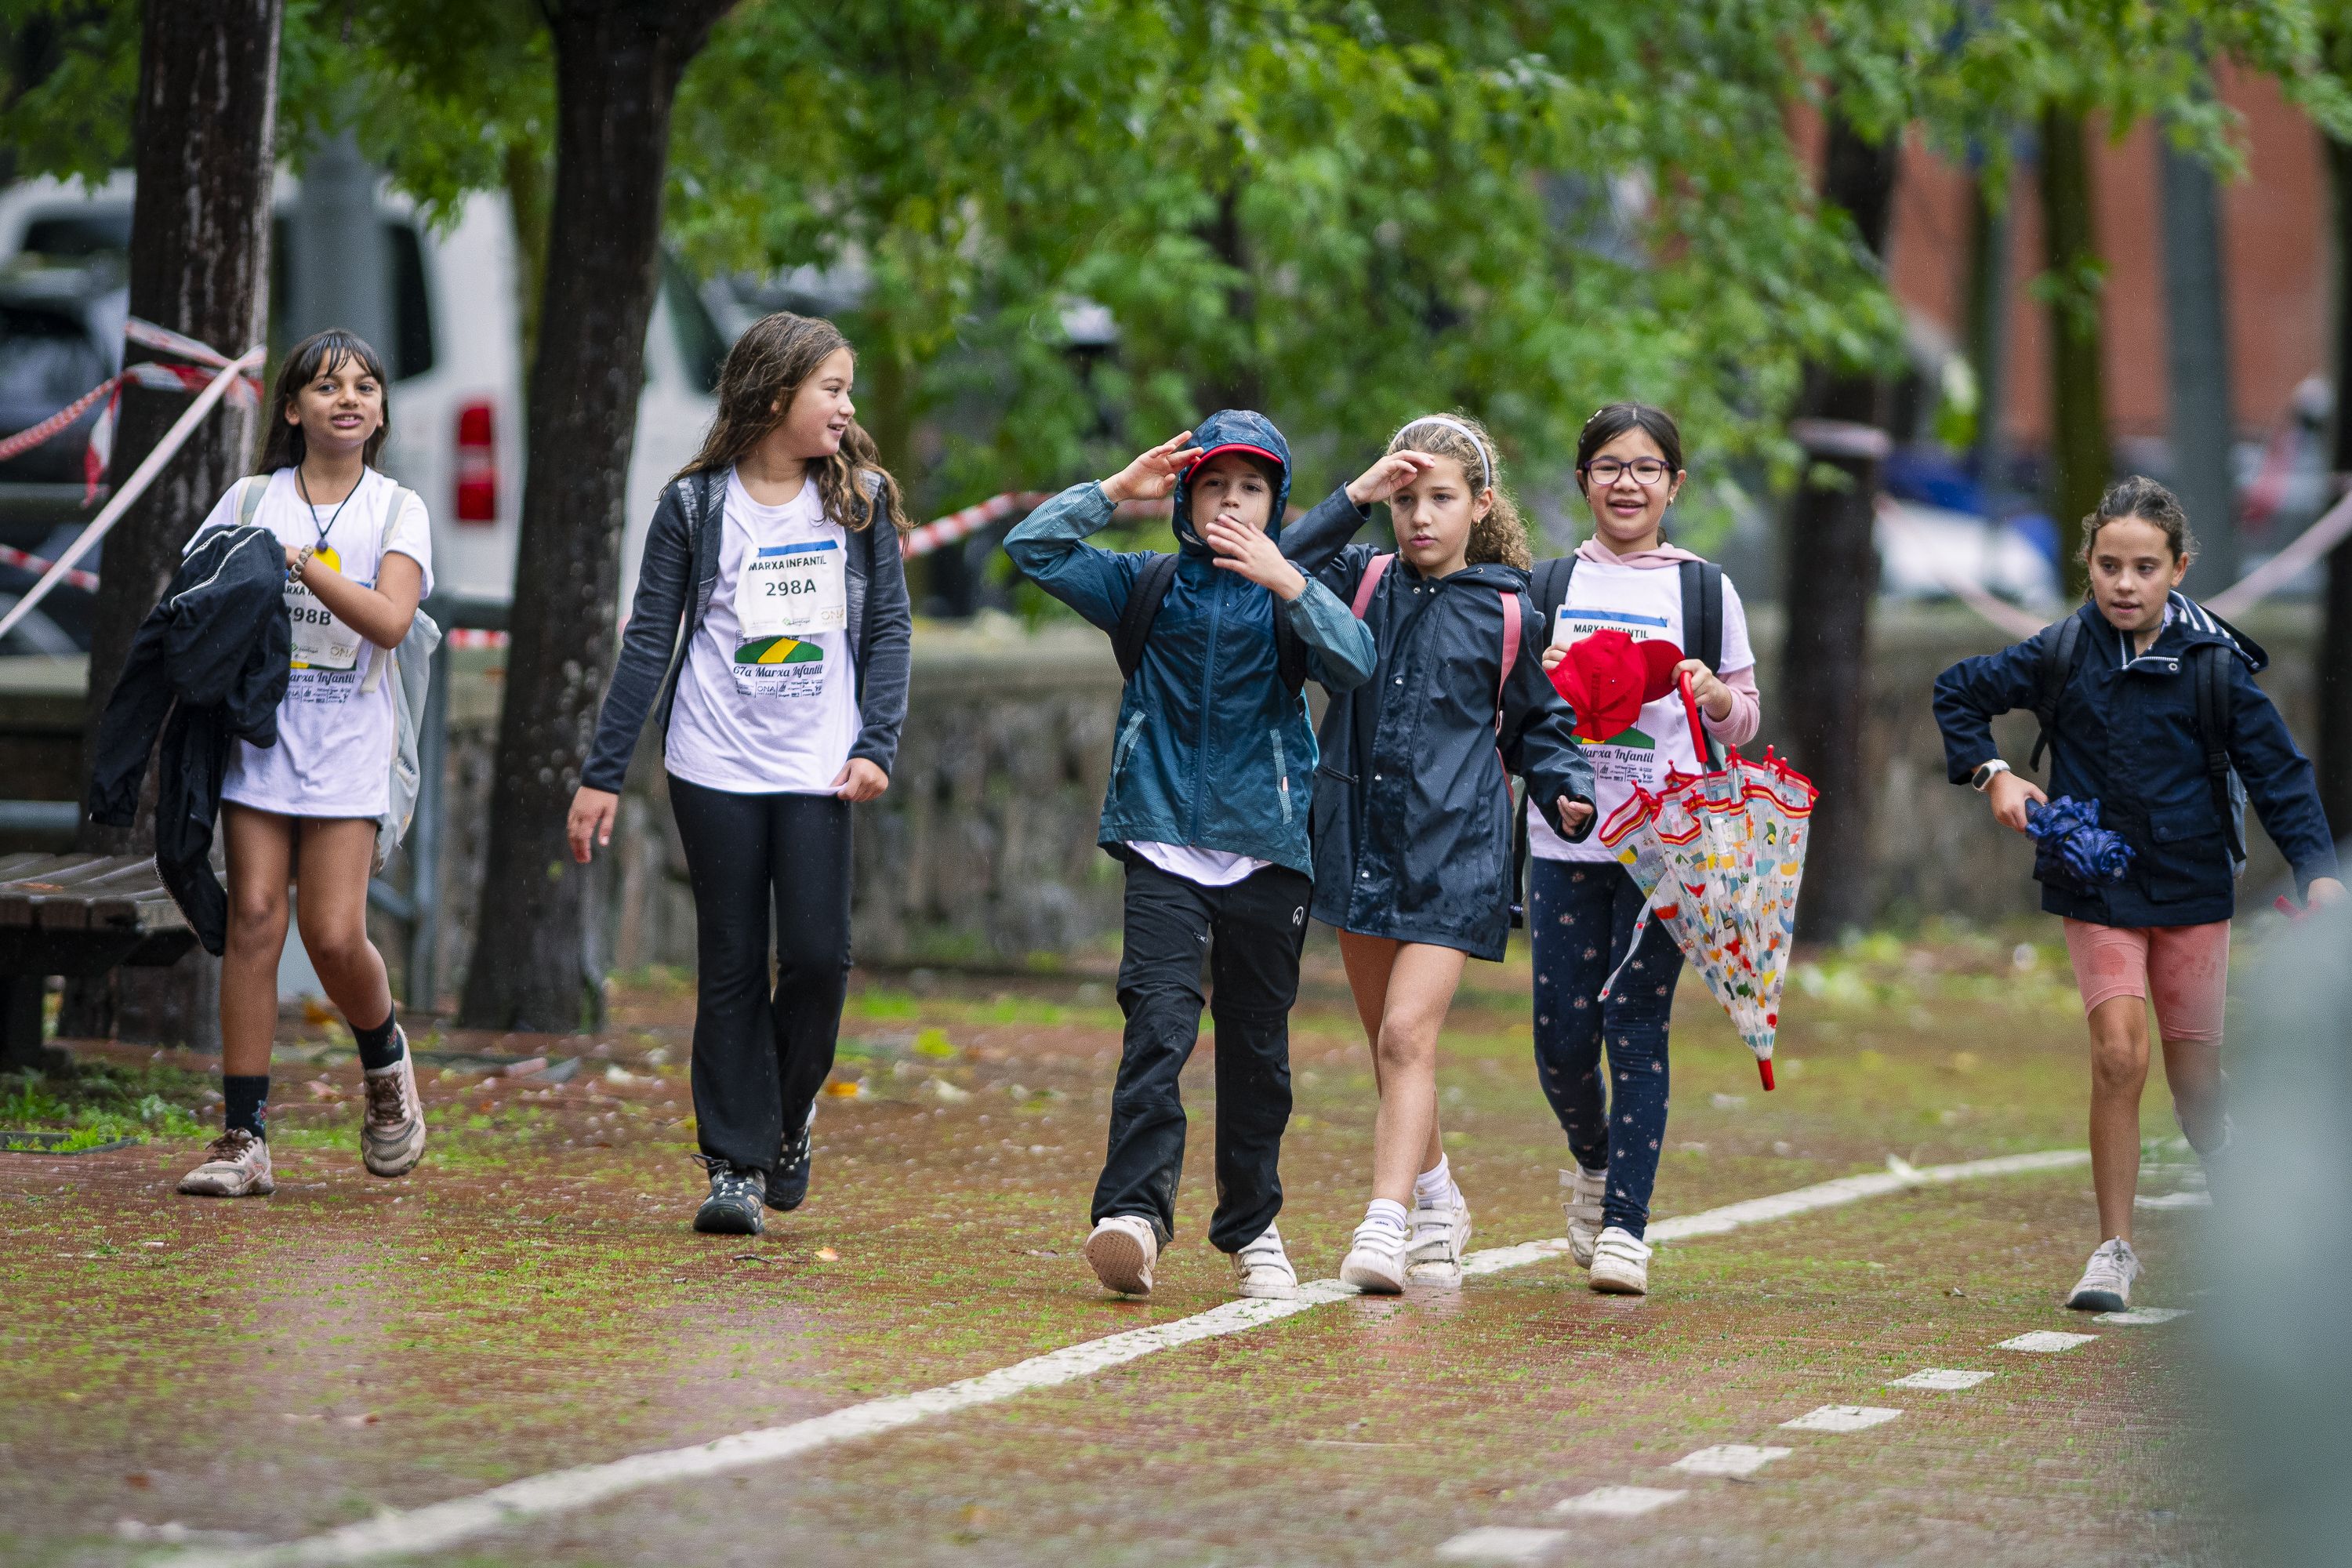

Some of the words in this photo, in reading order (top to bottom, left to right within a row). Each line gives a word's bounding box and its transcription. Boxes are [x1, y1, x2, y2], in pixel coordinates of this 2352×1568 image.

[748, 560, 785, 572] MARXA
[786, 555, 827, 568] INFANTIL
[284, 584, 306, 596] RXA
[765, 578, 817, 597] 298A
[287, 606, 332, 626] 98B
[1607, 626, 1649, 639] NTIL
[289, 673, 314, 683] arxa
[316, 671, 355, 686] Infantil
[732, 666, 753, 677] 67a
[755, 666, 790, 677] Marxa
[792, 663, 823, 679] Infantil
[1614, 748, 1654, 764] Infantil
